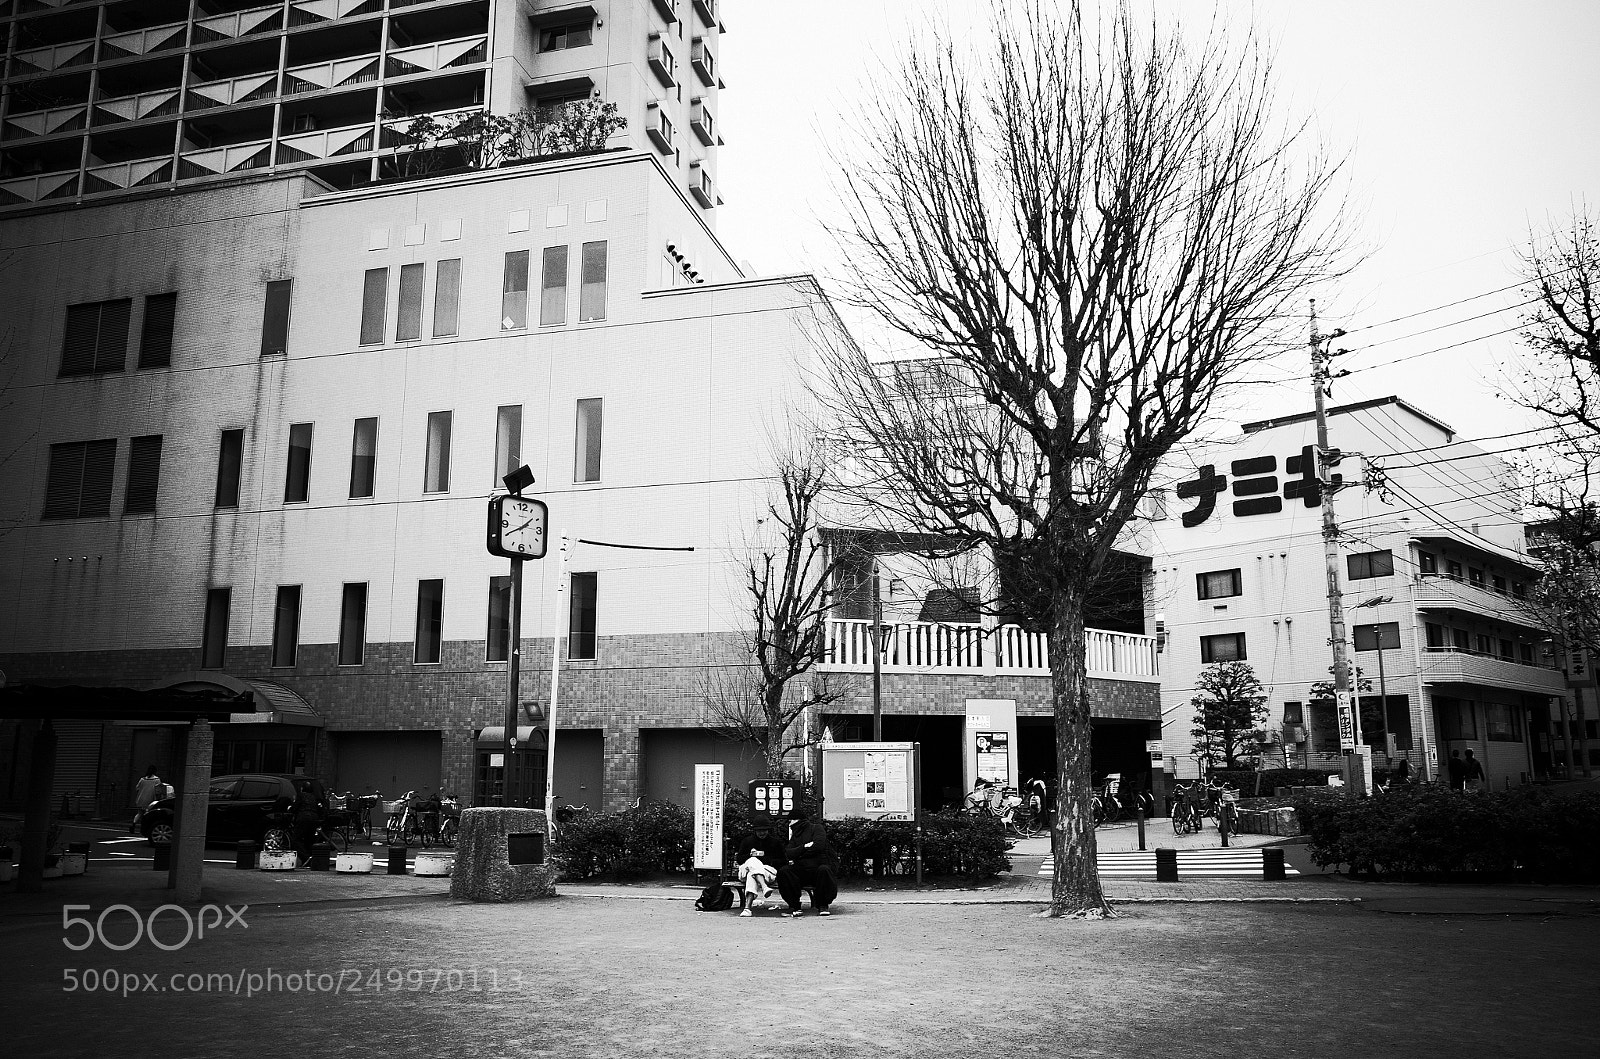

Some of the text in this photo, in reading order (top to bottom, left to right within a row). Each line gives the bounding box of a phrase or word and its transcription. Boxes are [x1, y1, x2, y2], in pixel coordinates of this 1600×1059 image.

[1177, 444, 1343, 528] ナミキ
[517, 502, 528, 512] 12
[501, 519, 509, 528] 9
[535, 526, 542, 535] 3
[518, 543, 525, 552] 6
